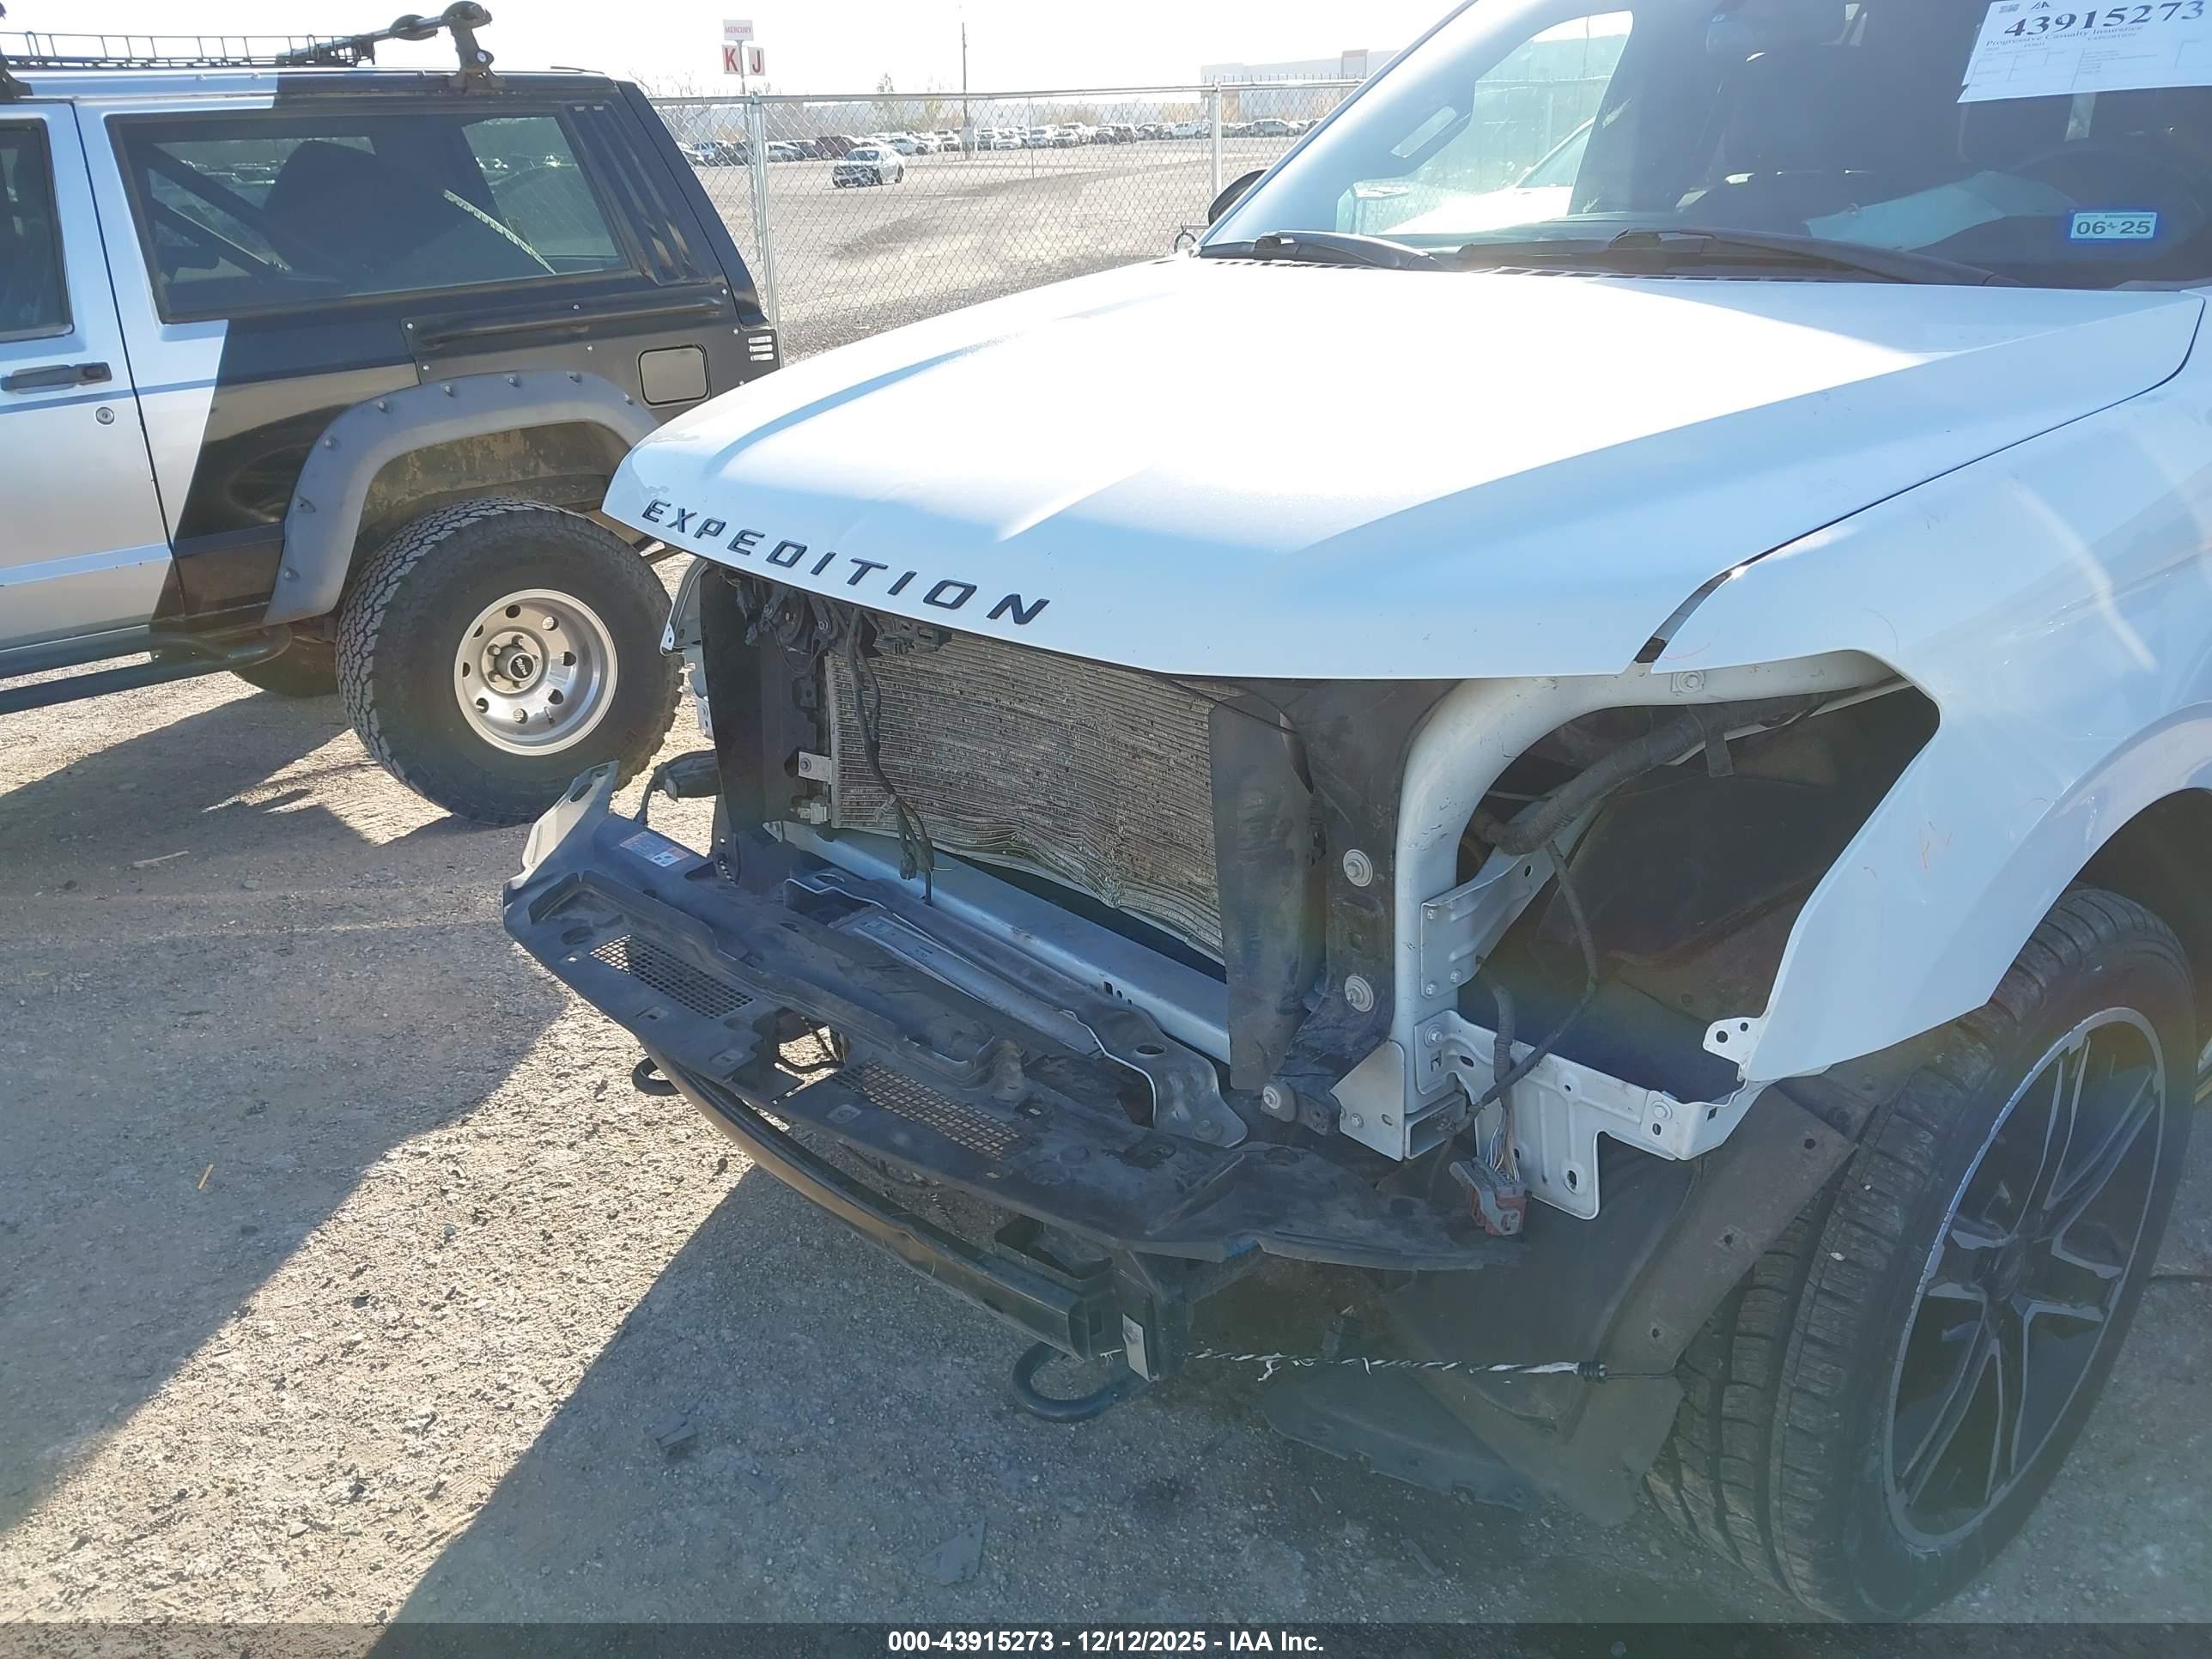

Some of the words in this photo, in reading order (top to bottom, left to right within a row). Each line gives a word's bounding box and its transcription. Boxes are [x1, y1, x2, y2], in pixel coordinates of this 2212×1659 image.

[2004, 0, 2205, 37] 43915273
[725, 47, 738, 71] K
[752, 50, 761, 74] J
[2076, 221, 2106, 234] 06
[2119, 221, 2151, 234] 25
[641, 499, 1050, 625] EXPEDITION
